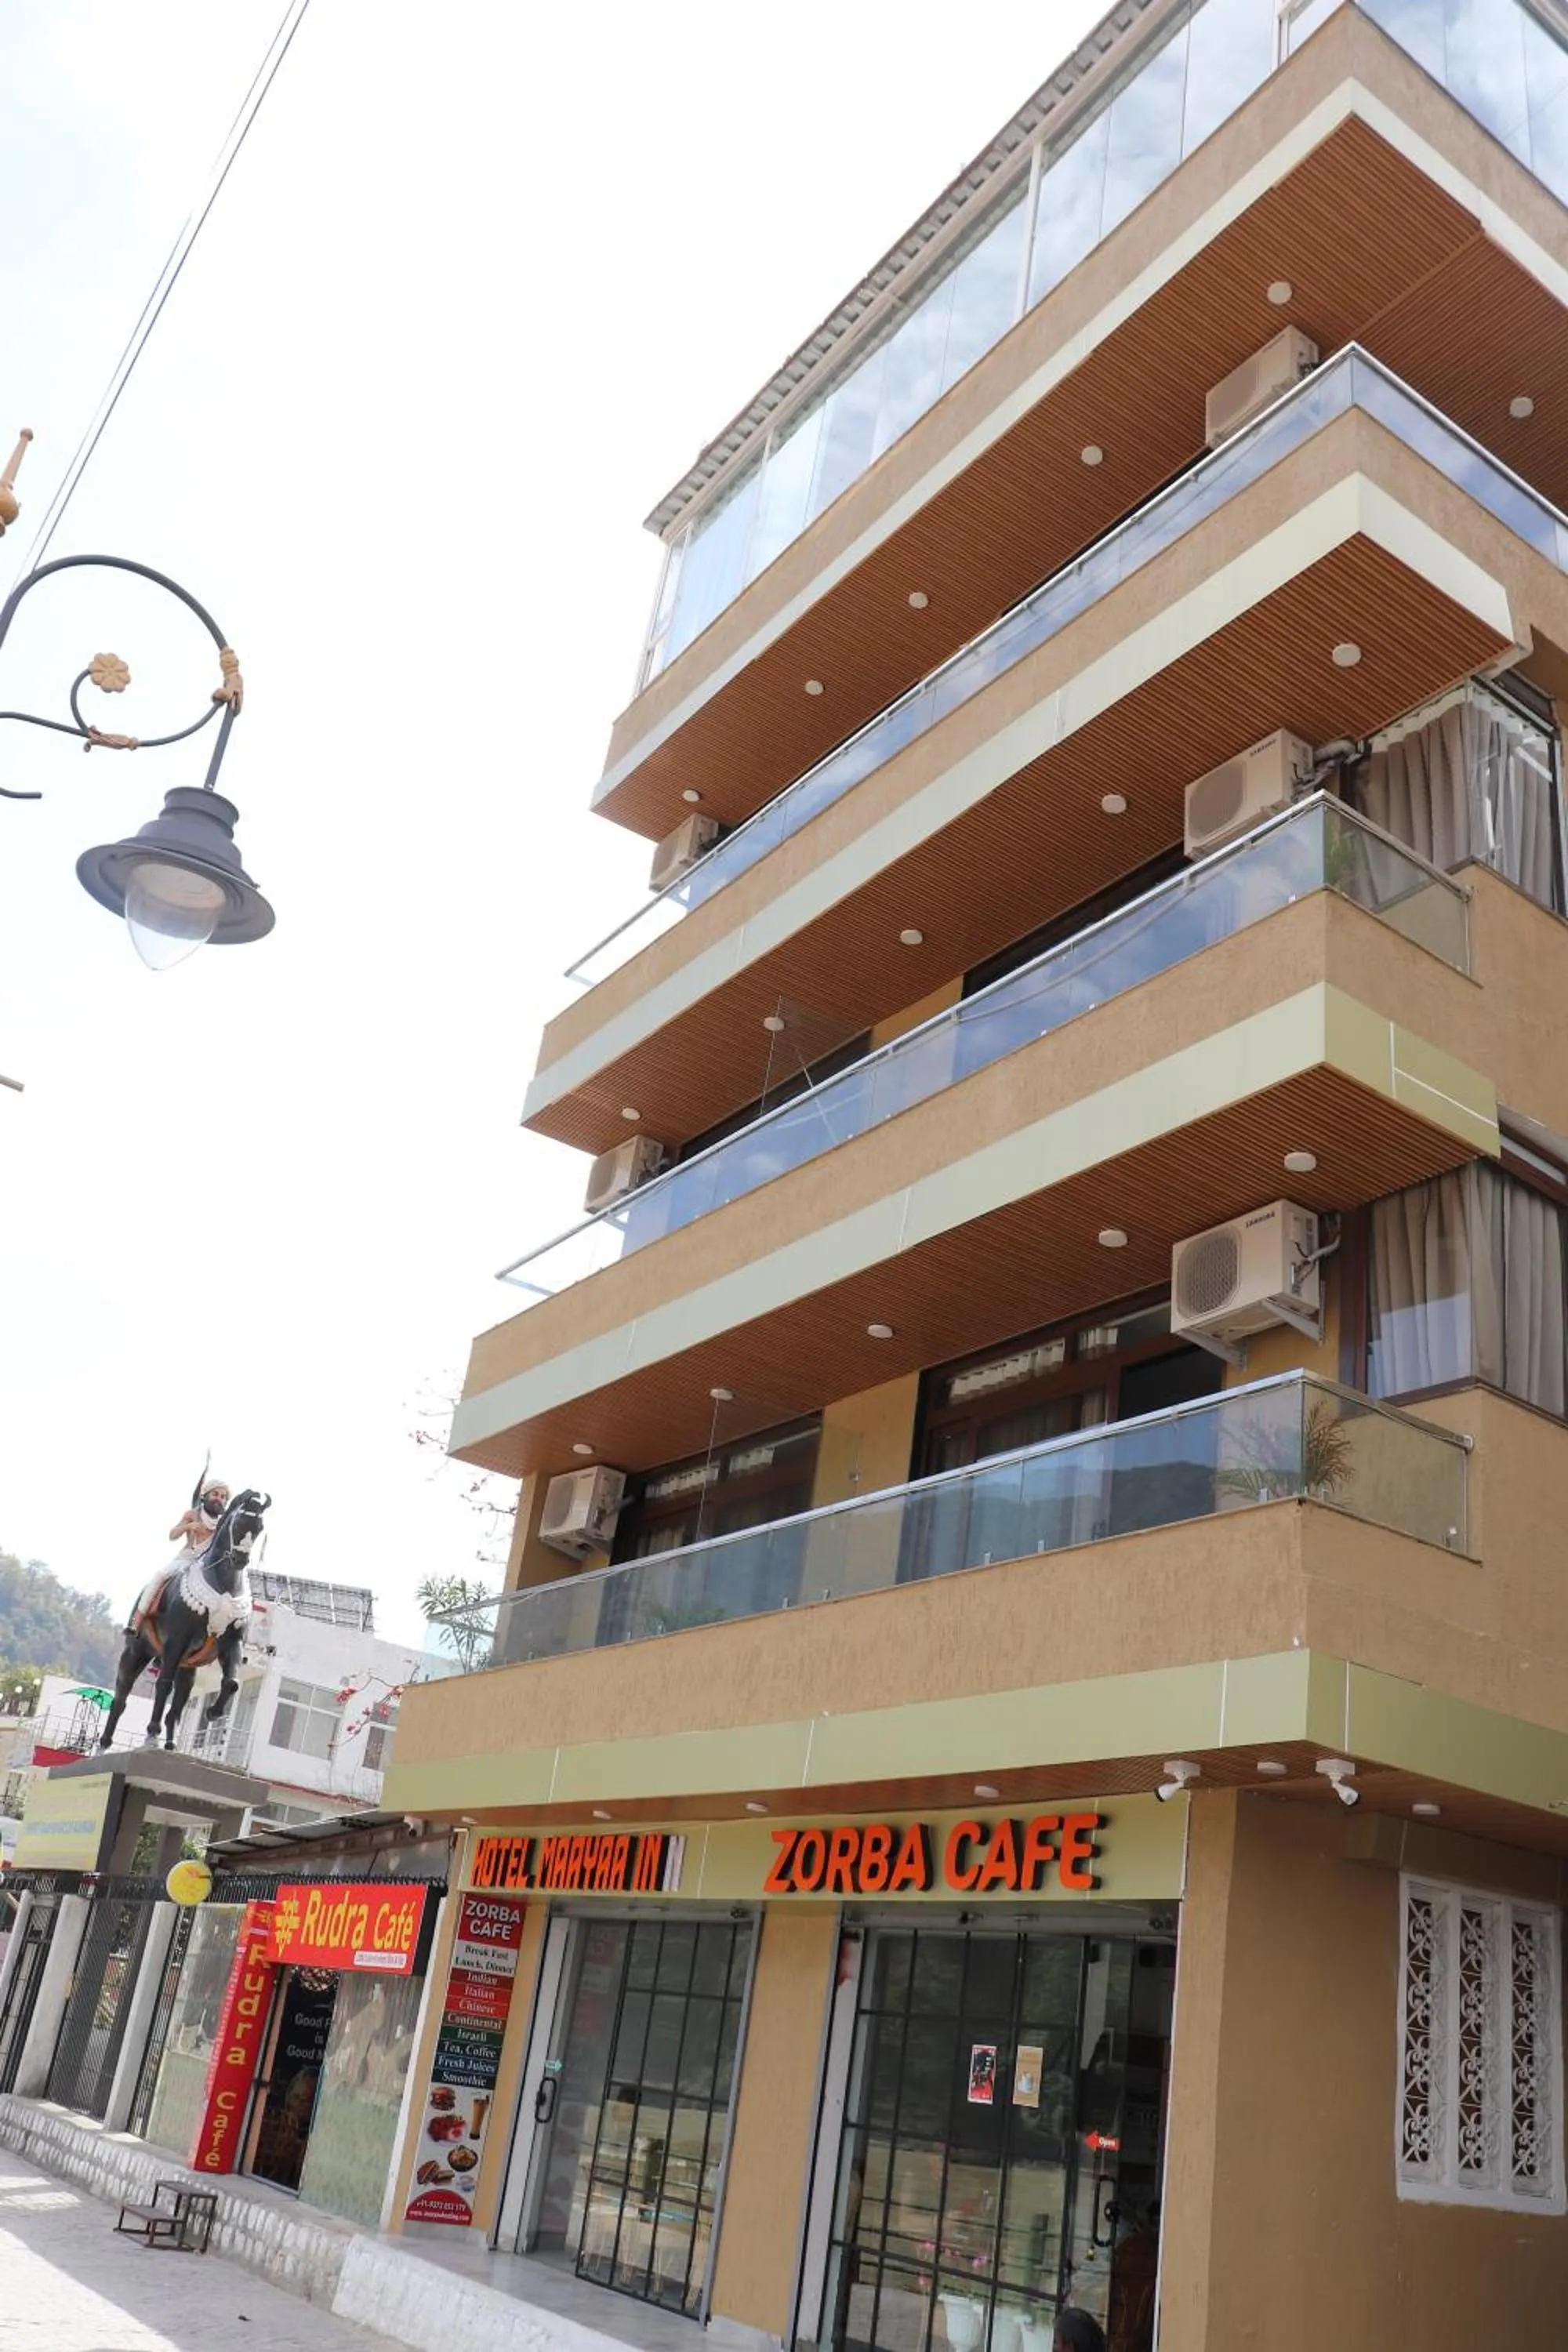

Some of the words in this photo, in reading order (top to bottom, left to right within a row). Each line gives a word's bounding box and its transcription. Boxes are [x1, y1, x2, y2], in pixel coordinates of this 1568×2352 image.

[762, 1822, 929, 1893] ZORBA
[944, 1812, 1101, 1893] CAFE
[470, 1837, 532, 1889] HOTEL
[300, 1889, 368, 1950] Rudra
[373, 1901, 416, 1951] Café
[466, 1900, 521, 1923] ZORBA
[470, 1919, 512, 1940] CAFE
[485, 1961, 514, 1973] Dinner
[466, 1972, 498, 1986] Indian
[464, 1985, 495, 2000] Italian
[226, 1944, 271, 2065] Rudra
[459, 1999, 496, 2014] Chinese
[294, 2012, 324, 2027] Good
[448, 2013, 502, 2030] Continental
[285, 2044, 316, 2060] Good
[465, 2044, 496, 2058] Coffee
[438, 2055, 465, 2068] Fresh
[466, 2060, 495, 2072] Juices
[205, 2091, 238, 2167] Café
